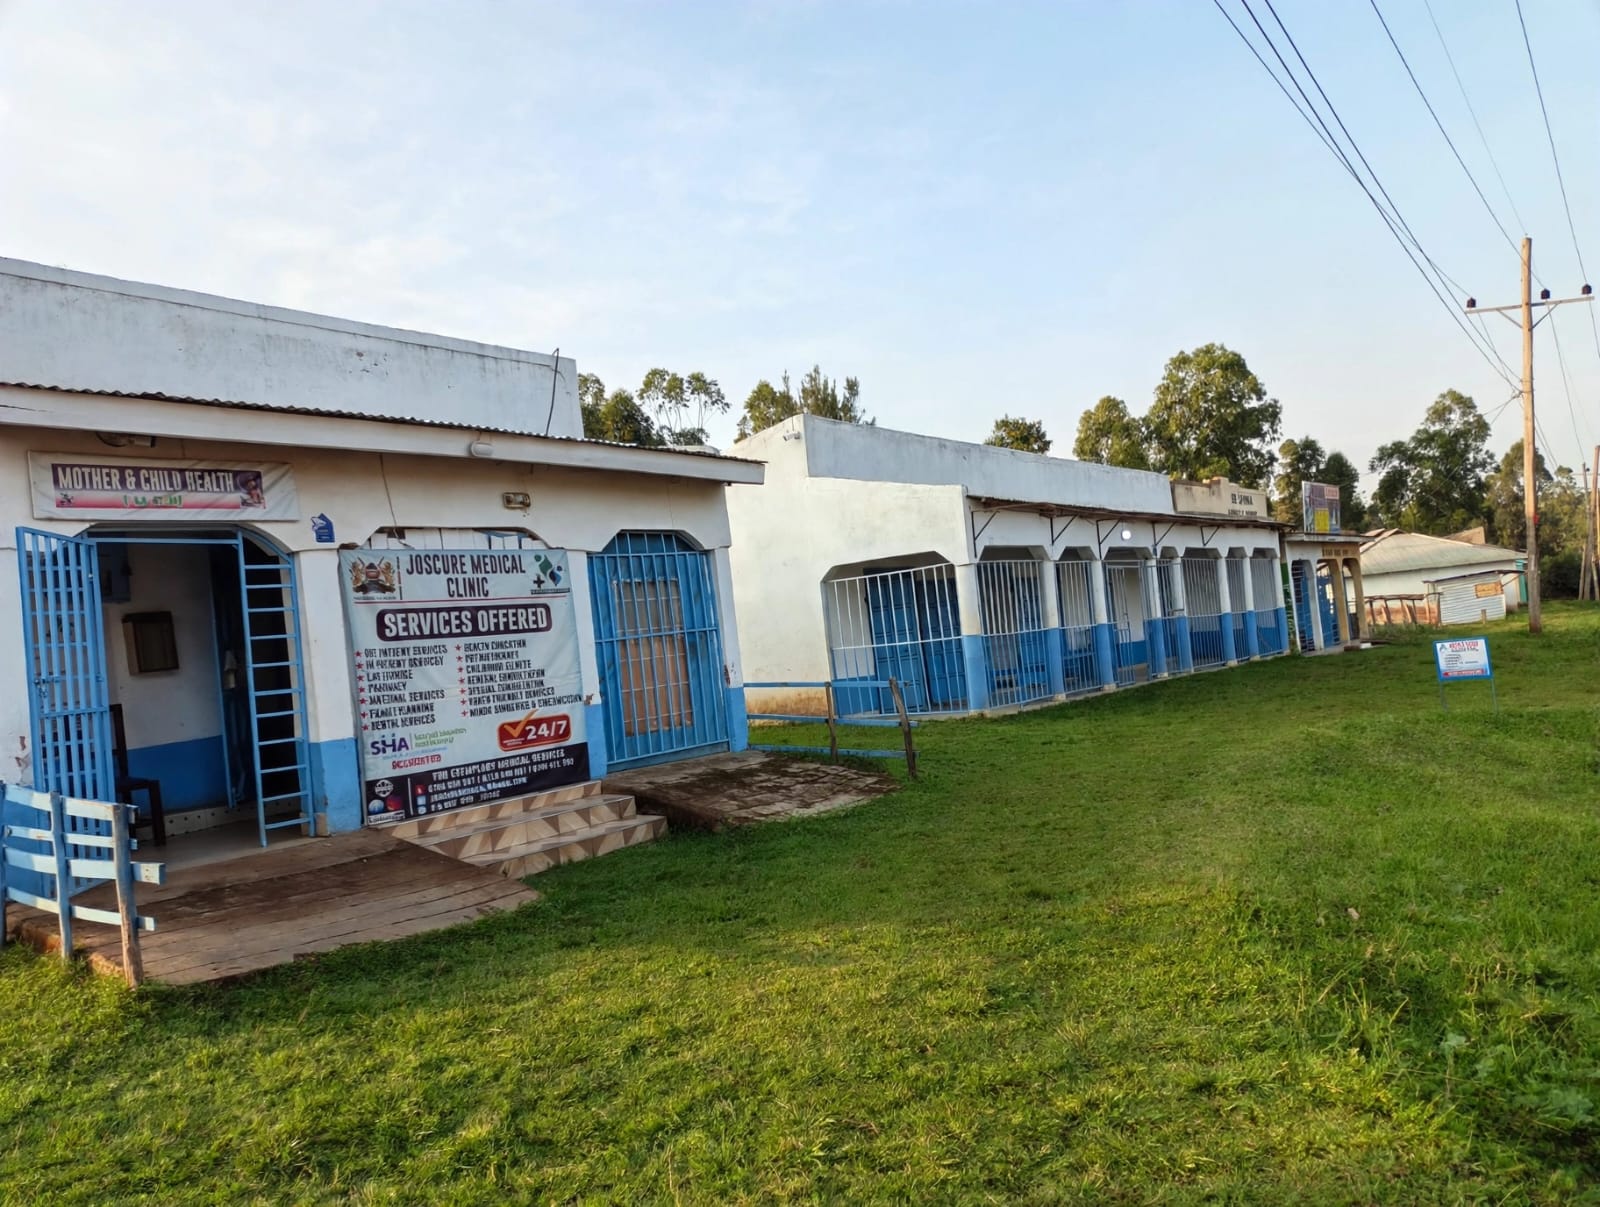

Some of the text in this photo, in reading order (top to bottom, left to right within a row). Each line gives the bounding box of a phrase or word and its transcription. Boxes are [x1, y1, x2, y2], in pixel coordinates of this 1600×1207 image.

[58, 467, 234, 493] MOTHER & CHILD HEALTH
[406, 554, 526, 575] JOSCURE MEDICAL
[447, 577, 489, 598] CLINIC
[384, 607, 548, 638] SERVICES OFFERED
[525, 720, 567, 740] 24/7
[371, 733, 409, 755] SHA
